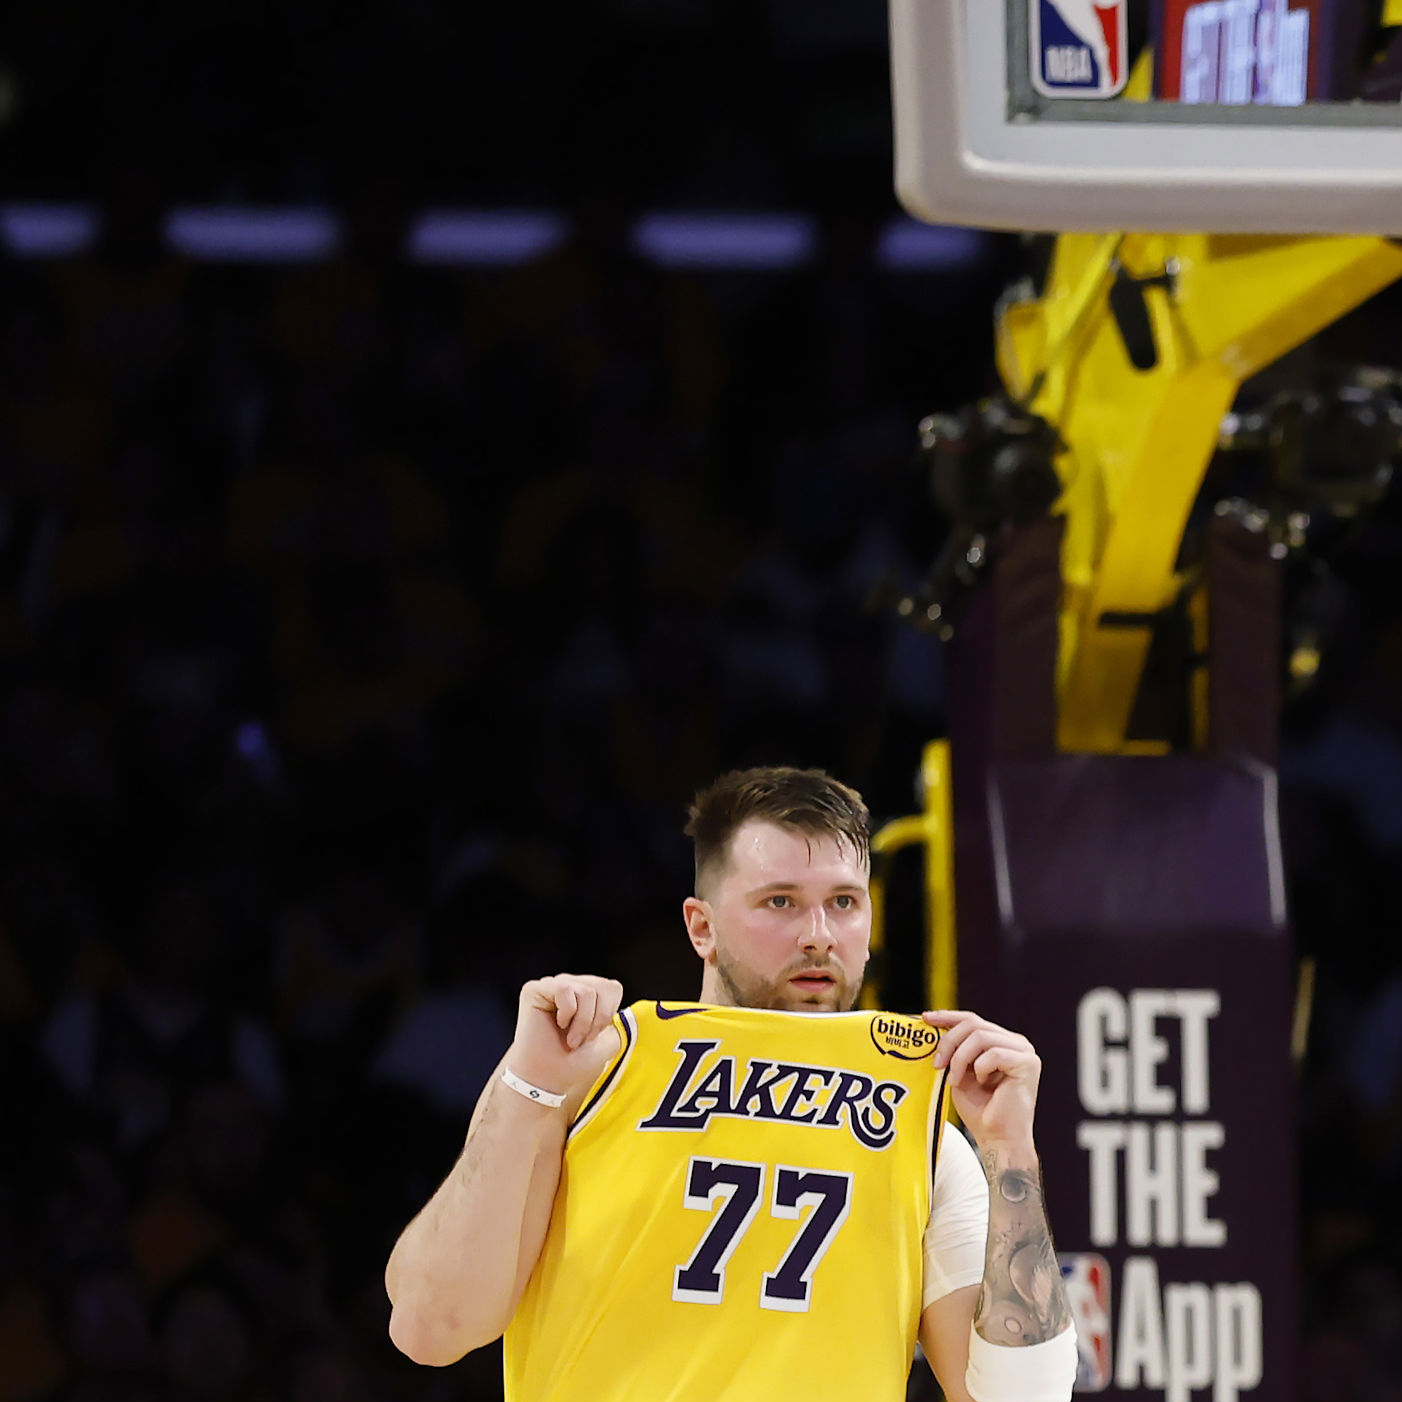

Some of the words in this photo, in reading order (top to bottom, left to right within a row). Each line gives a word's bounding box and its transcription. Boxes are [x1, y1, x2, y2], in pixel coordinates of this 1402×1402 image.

[636, 1039, 909, 1151] LAKERS
[877, 1019, 936, 1047] bibigo
[1076, 987, 1221, 1115] GET
[672, 1155, 854, 1312] 77
[1076, 1121, 1227, 1247] THE
